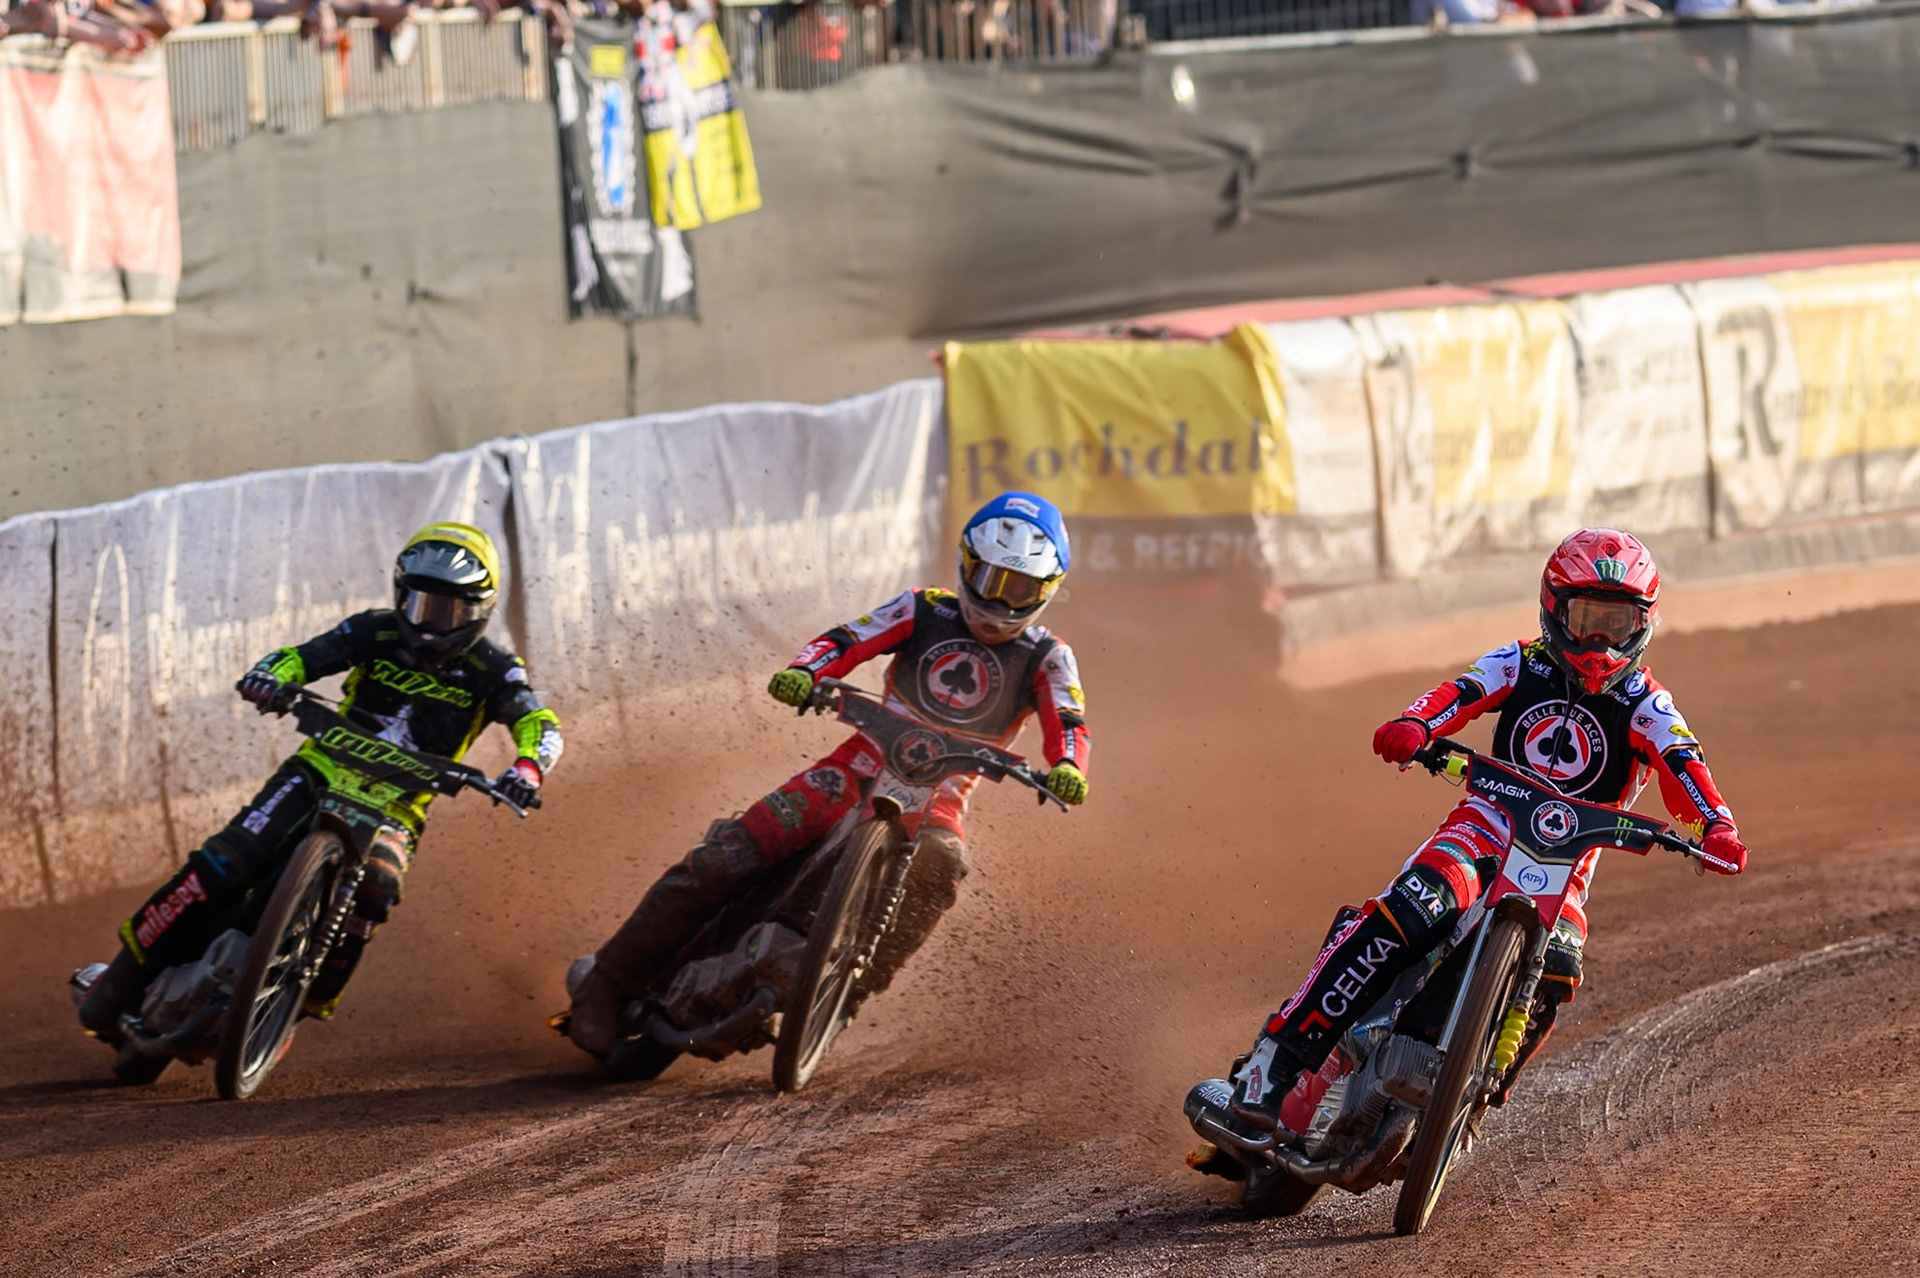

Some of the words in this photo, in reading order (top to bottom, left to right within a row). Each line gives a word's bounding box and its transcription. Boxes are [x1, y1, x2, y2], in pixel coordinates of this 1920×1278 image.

[1522, 705, 1556, 729] BELLE
[1584, 723, 1602, 753] ACES
[1405, 875, 1444, 918] DVR
[1522, 872, 1543, 885] ATPI
[1321, 936, 1400, 1017] CELKA
